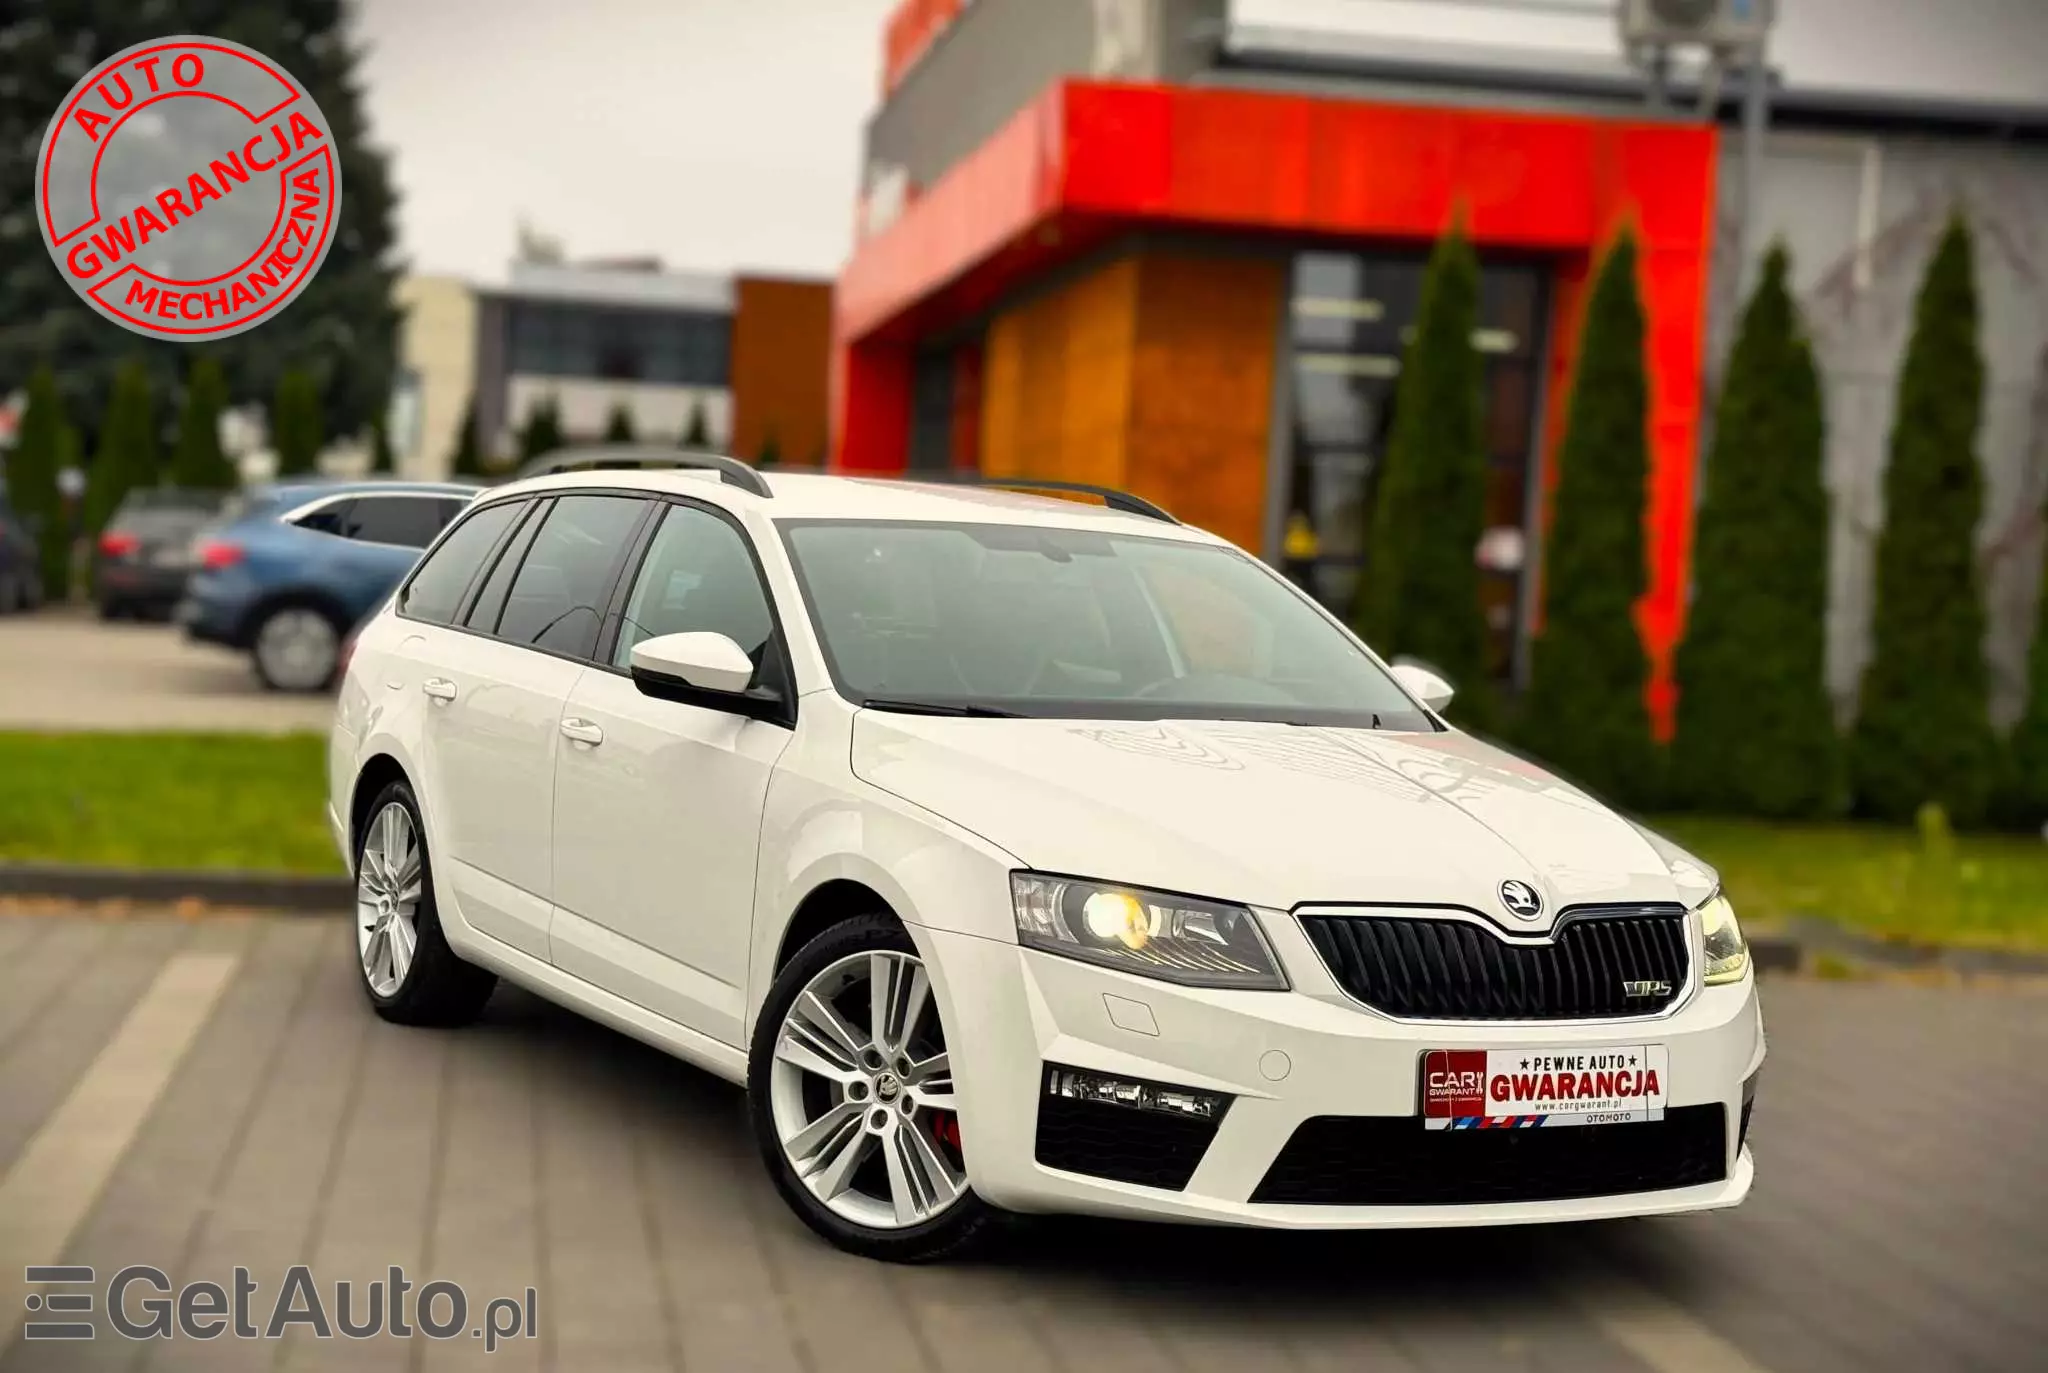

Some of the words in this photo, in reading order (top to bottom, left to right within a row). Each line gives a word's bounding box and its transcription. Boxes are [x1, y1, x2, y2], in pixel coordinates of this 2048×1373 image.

[1533, 1056, 1584, 1071] PEWNE
[1589, 1055, 1625, 1070] AUTO
[1429, 1071, 1476, 1088] CAR
[1490, 1069, 1660, 1103] GWARANCJA
[1586, 1112, 1632, 1124] OTOMOTO
